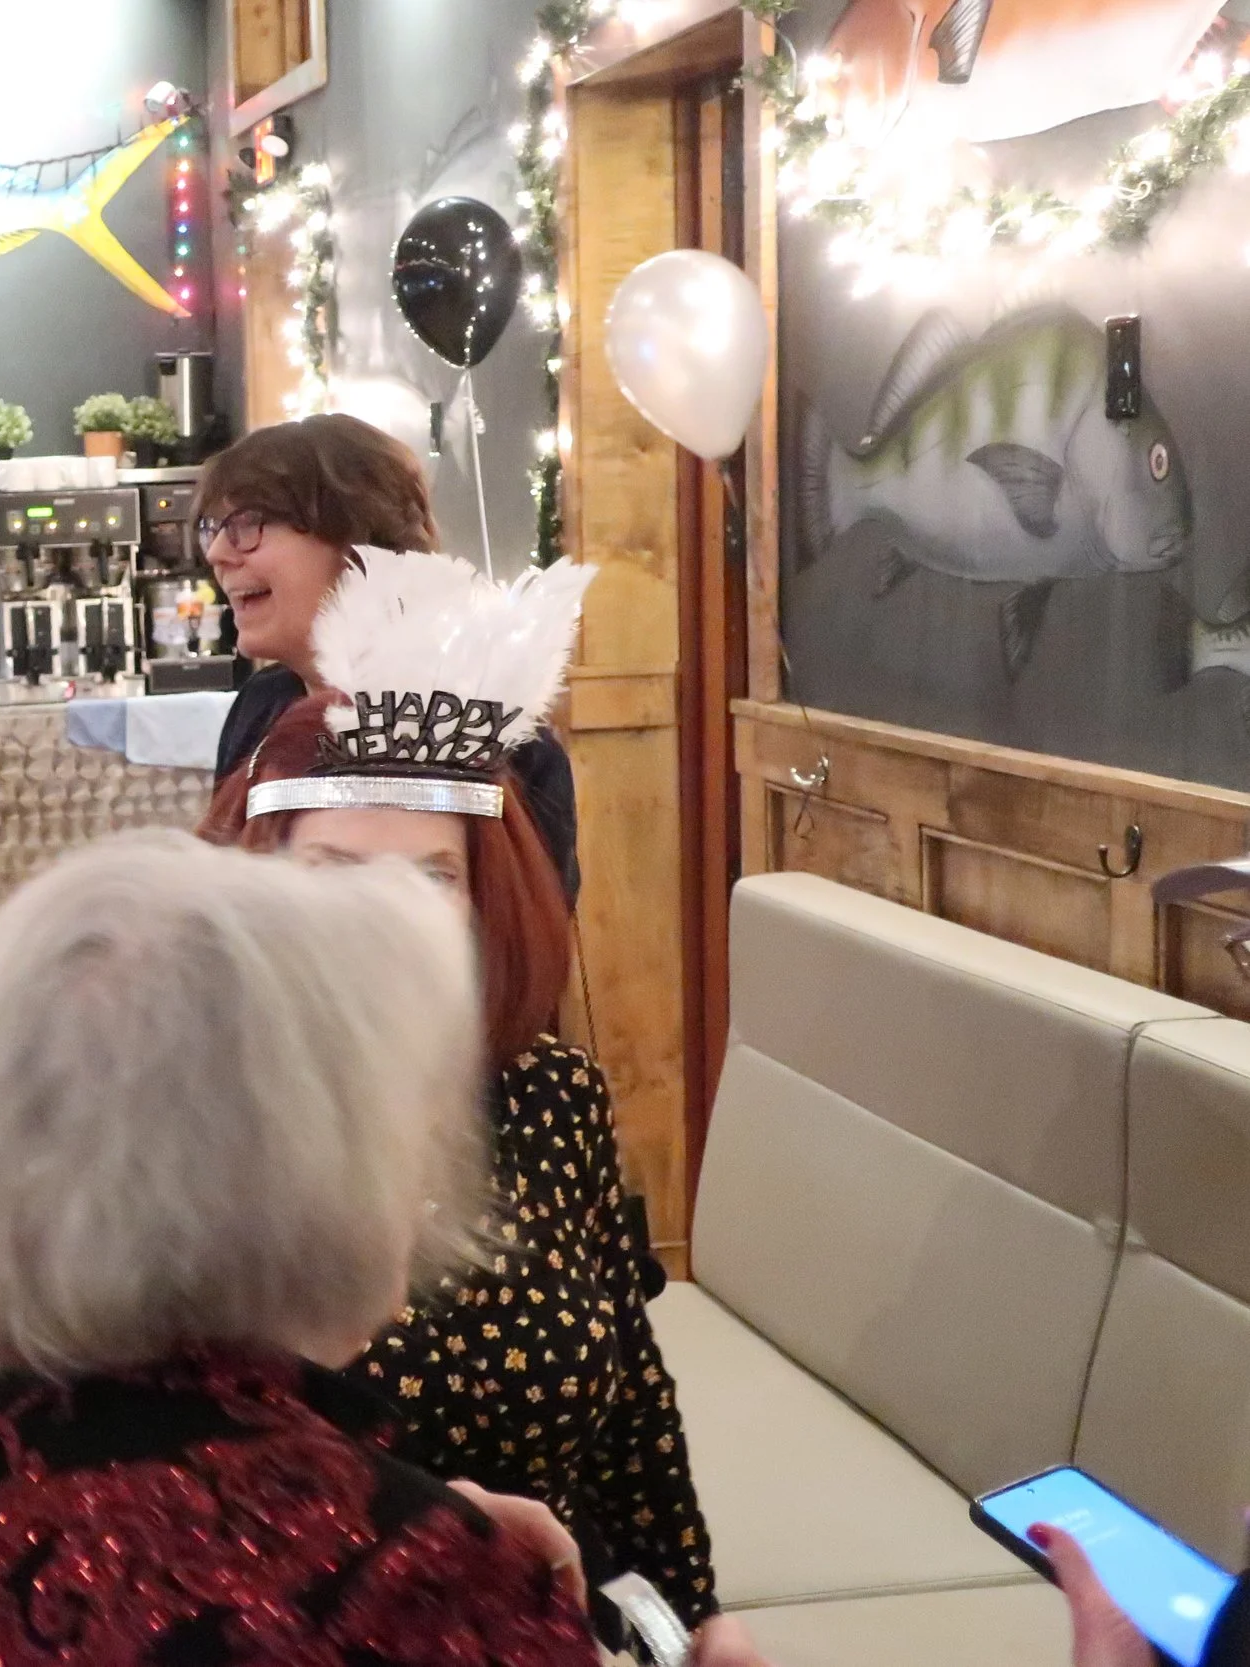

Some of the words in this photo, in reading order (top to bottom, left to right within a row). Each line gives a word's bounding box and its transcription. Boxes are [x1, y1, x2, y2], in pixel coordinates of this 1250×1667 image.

[355, 690, 524, 741] HAPPY
[315, 725, 428, 765] NEW
[422, 726, 510, 769] YEA
